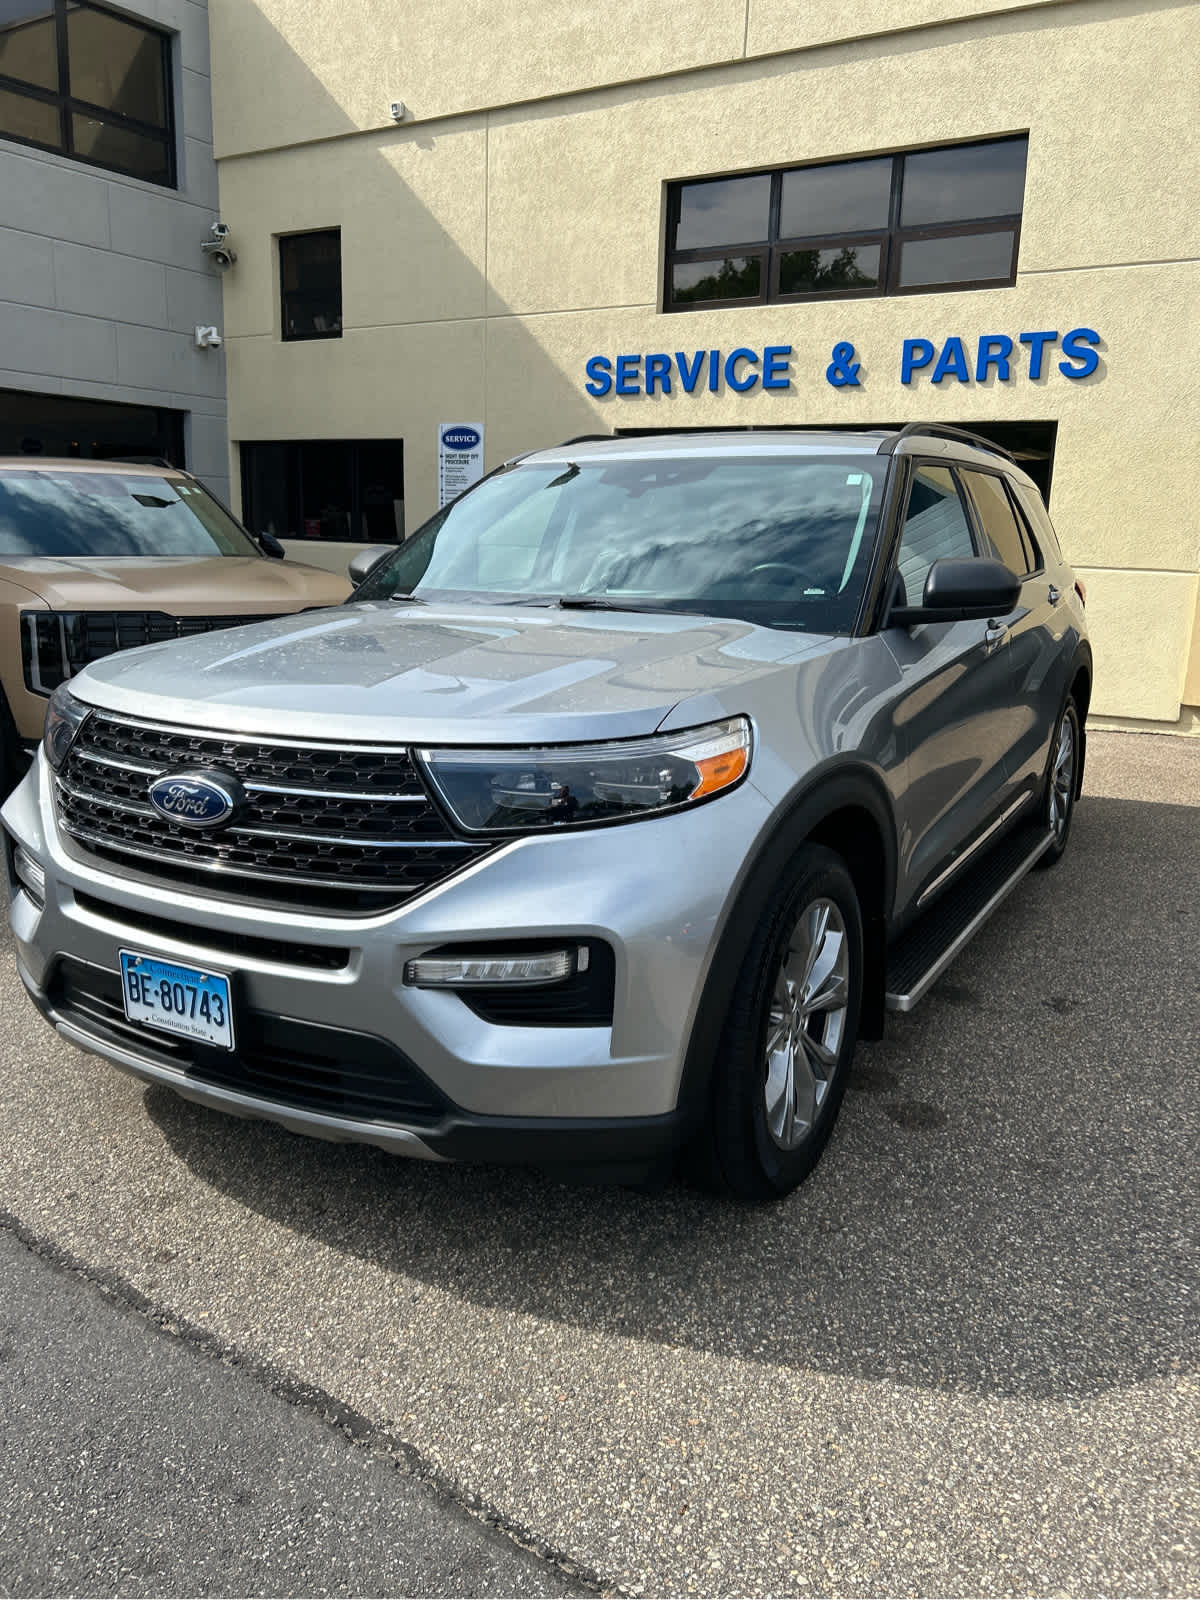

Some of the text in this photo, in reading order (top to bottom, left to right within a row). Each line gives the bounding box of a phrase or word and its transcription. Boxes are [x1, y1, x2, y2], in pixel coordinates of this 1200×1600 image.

[585, 328, 1103, 397] SERVICE & PARTS
[163, 784, 209, 815] Ford
[191, 1025, 207, 1037] State
